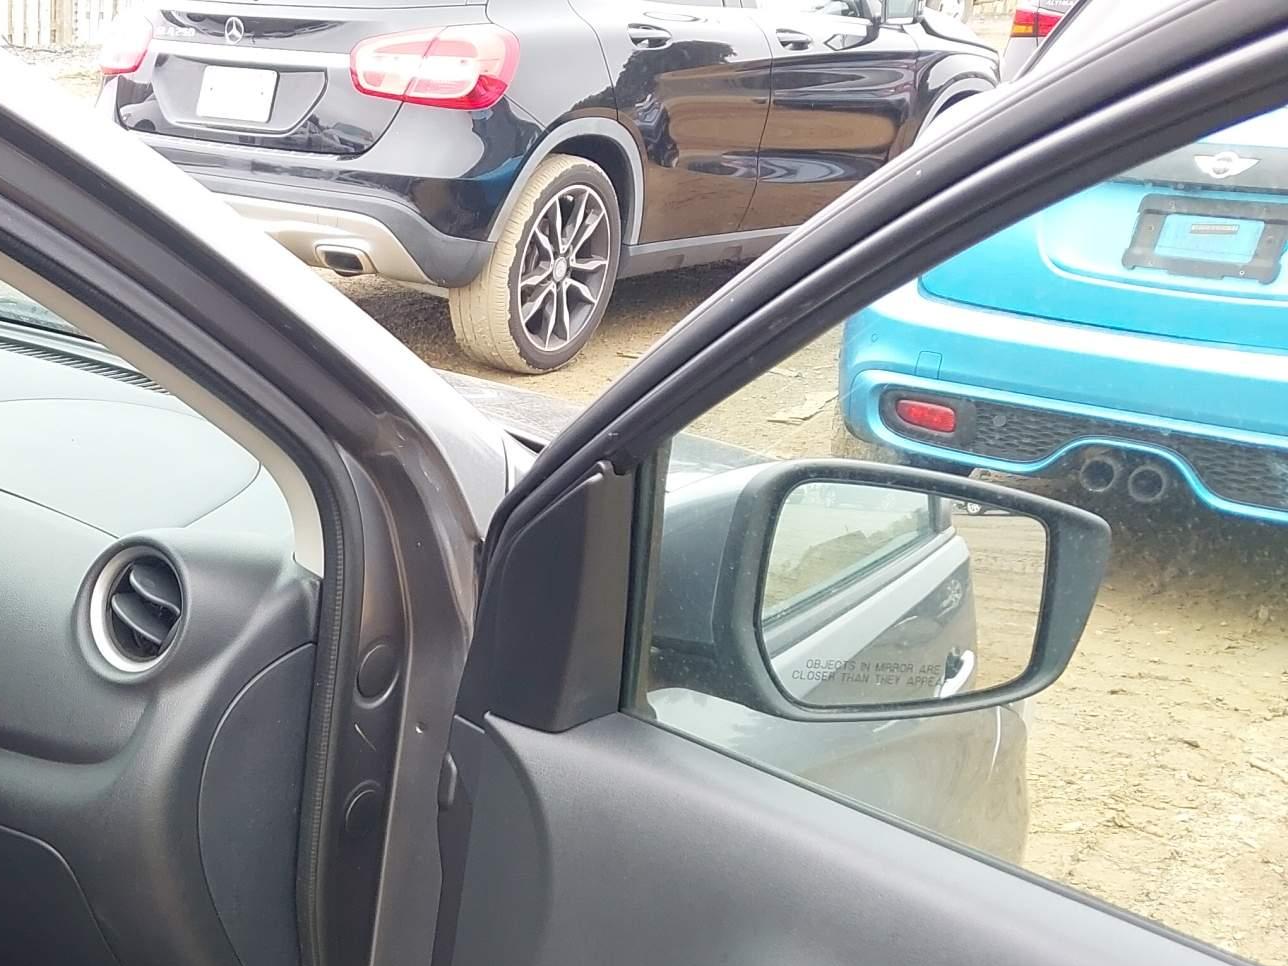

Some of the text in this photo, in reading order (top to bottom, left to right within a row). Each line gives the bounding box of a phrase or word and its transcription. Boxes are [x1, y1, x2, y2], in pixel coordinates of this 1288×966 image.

[806, 659, 941, 676] OBJECTS IN MIRROR ARE
[792, 669, 946, 687] CLOSER THAN THEY APPEA
